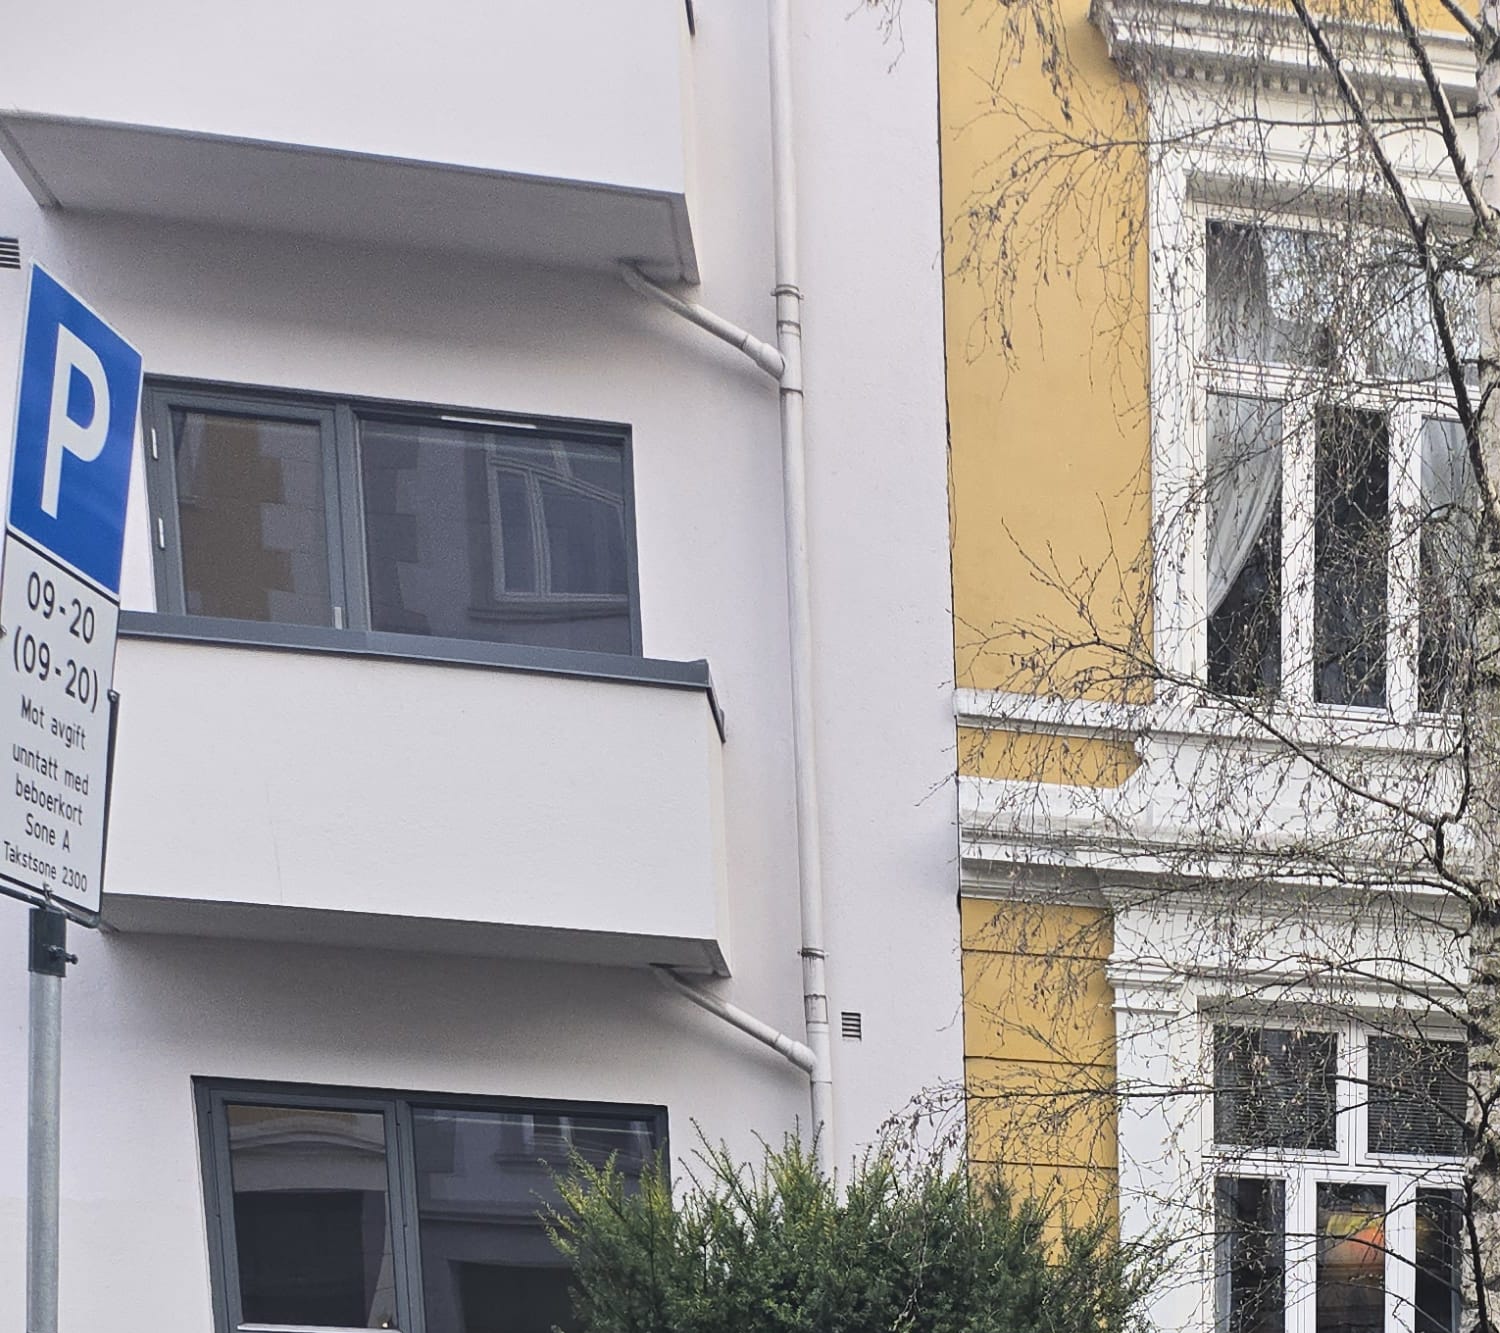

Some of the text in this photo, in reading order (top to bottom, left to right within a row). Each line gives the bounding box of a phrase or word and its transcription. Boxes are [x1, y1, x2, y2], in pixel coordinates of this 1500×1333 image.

[41, 323, 110, 519] P
[20, 694, 87, 751] Mot avgift
[12, 743, 89, 796] unntatt med
[15, 772, 83, 826] beboerkort
[24, 812, 71, 853] Sone A
[3, 840, 88, 893] Takstsone 2300
